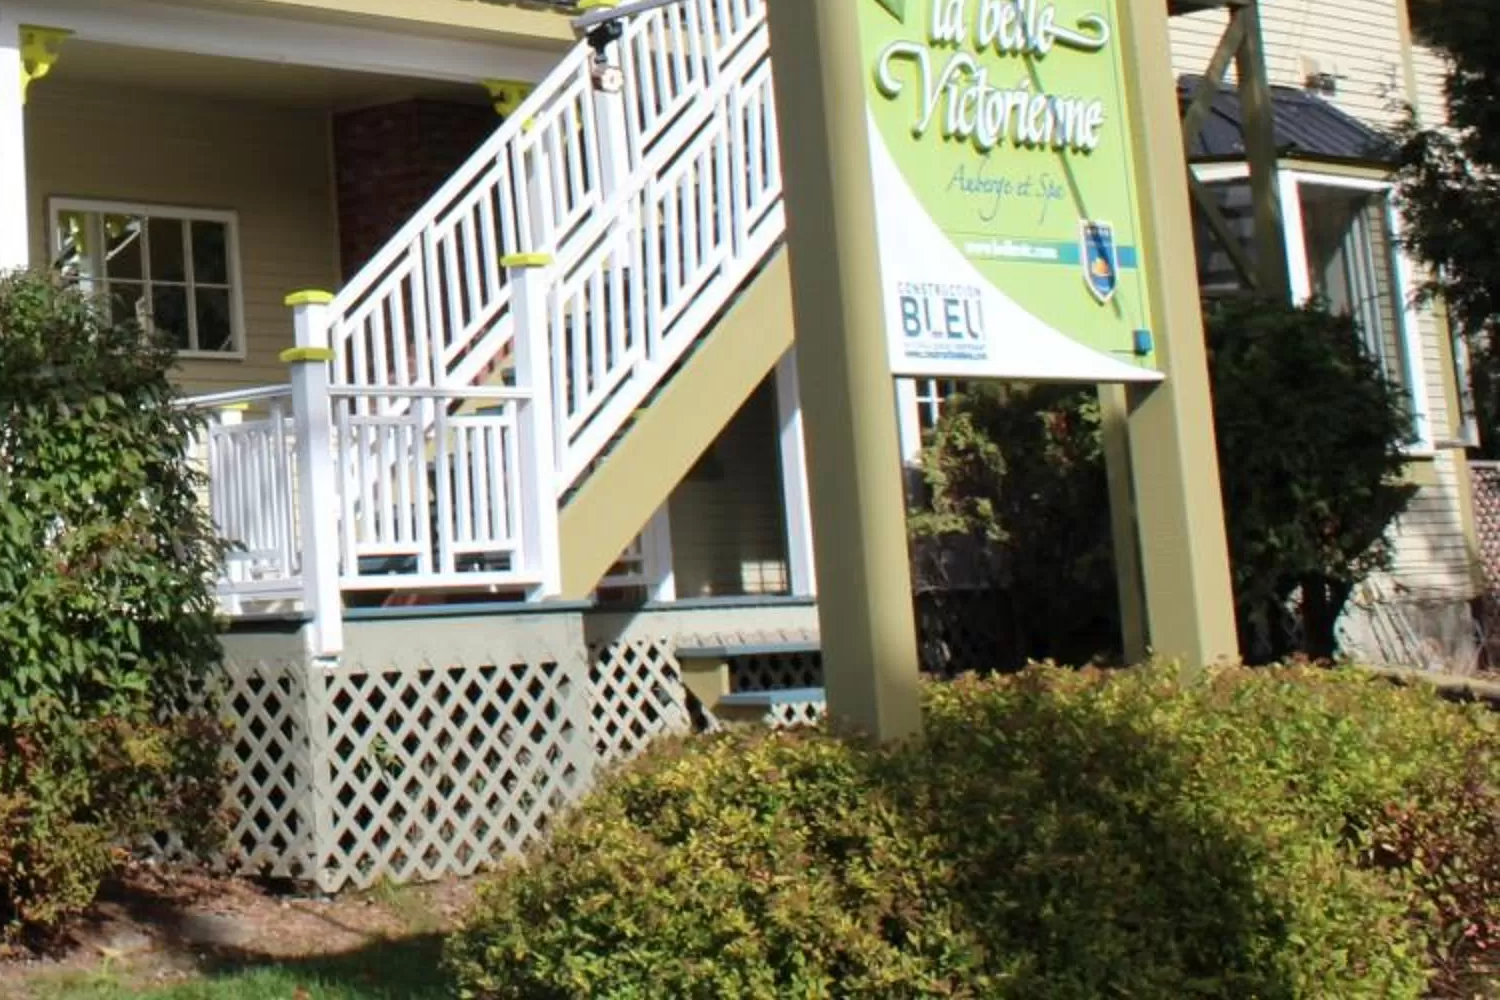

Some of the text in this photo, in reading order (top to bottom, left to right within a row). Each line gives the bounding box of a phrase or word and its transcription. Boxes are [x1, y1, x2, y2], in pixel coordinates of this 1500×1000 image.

[876, 41, 1106, 152] Victorienne
[946, 159, 1064, 224] Auberge et Spa
[900, 296, 985, 339] BLEU
